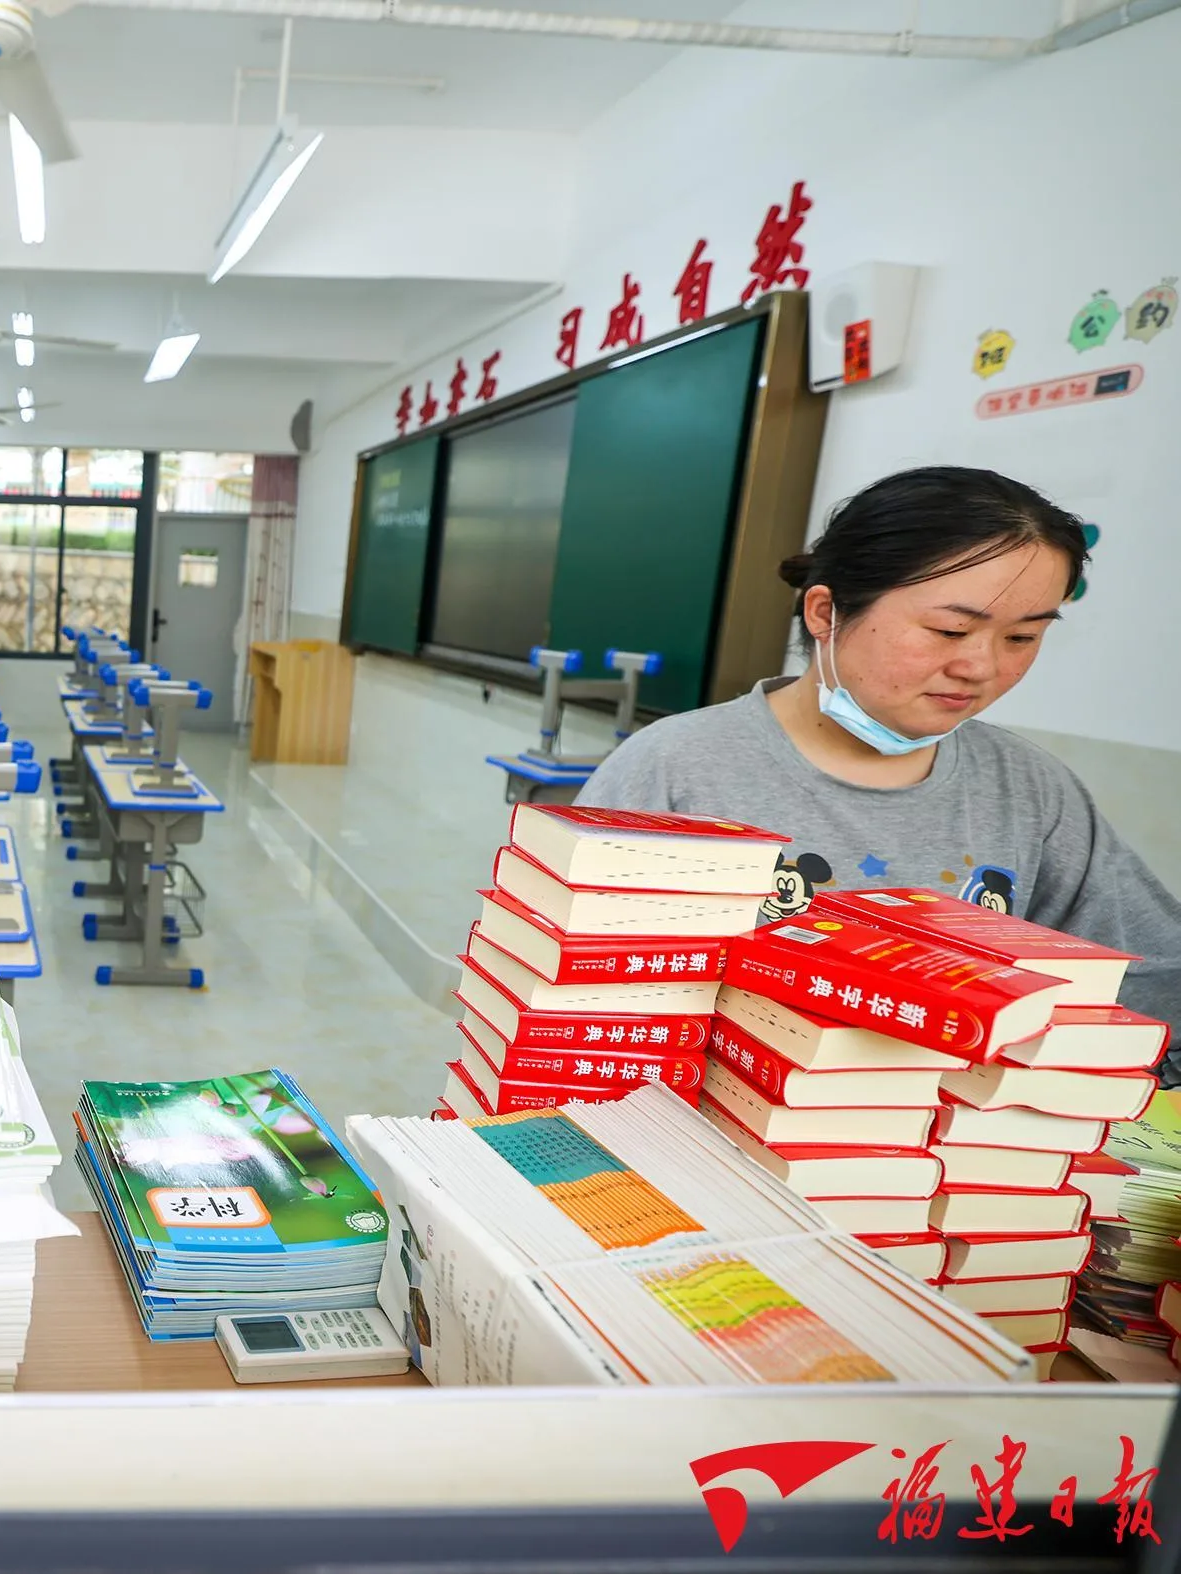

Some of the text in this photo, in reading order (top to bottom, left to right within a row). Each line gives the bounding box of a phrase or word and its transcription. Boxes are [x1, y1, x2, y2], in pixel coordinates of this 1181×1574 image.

[1079, 315, 1107, 338] 公
[624, 952, 708, 974] 新华字典
[806, 975, 928, 1030] 新华字典
[582, 1024, 670, 1044] 新华字典
[572, 1058, 663, 1081] 新华字典
[169, 1196, 245, 1218] 科学
